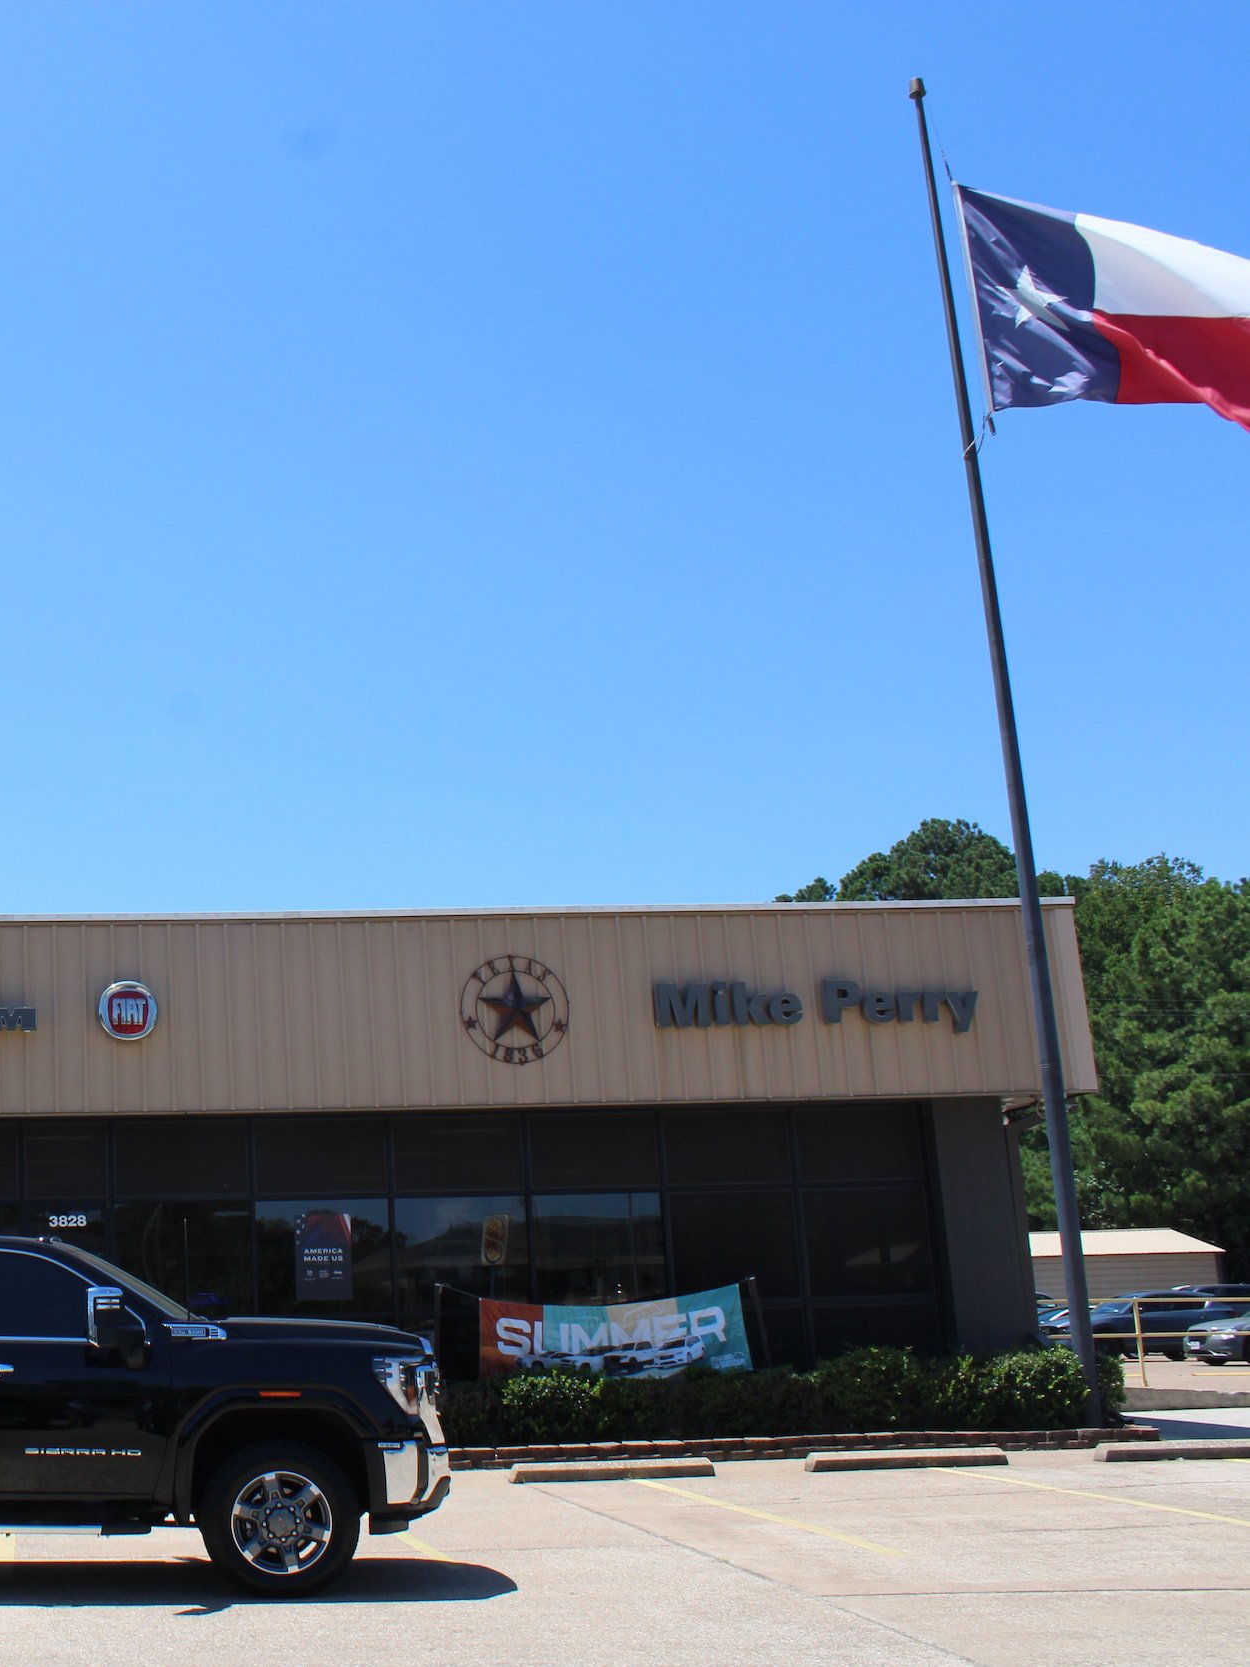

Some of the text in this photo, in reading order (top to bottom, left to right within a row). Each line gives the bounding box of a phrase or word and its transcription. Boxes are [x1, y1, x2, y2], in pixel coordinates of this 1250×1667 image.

[471, 955, 551, 985] TEXAS
[112, 997, 147, 1025] FIAT
[654, 978, 979, 1034] Mike Perry
[491, 1041, 545, 1066] 1836
[48, 1214, 87, 1228] 3828
[495, 1305, 727, 1356] SUMMER
[24, 1447, 142, 1456] SIERRA HD
